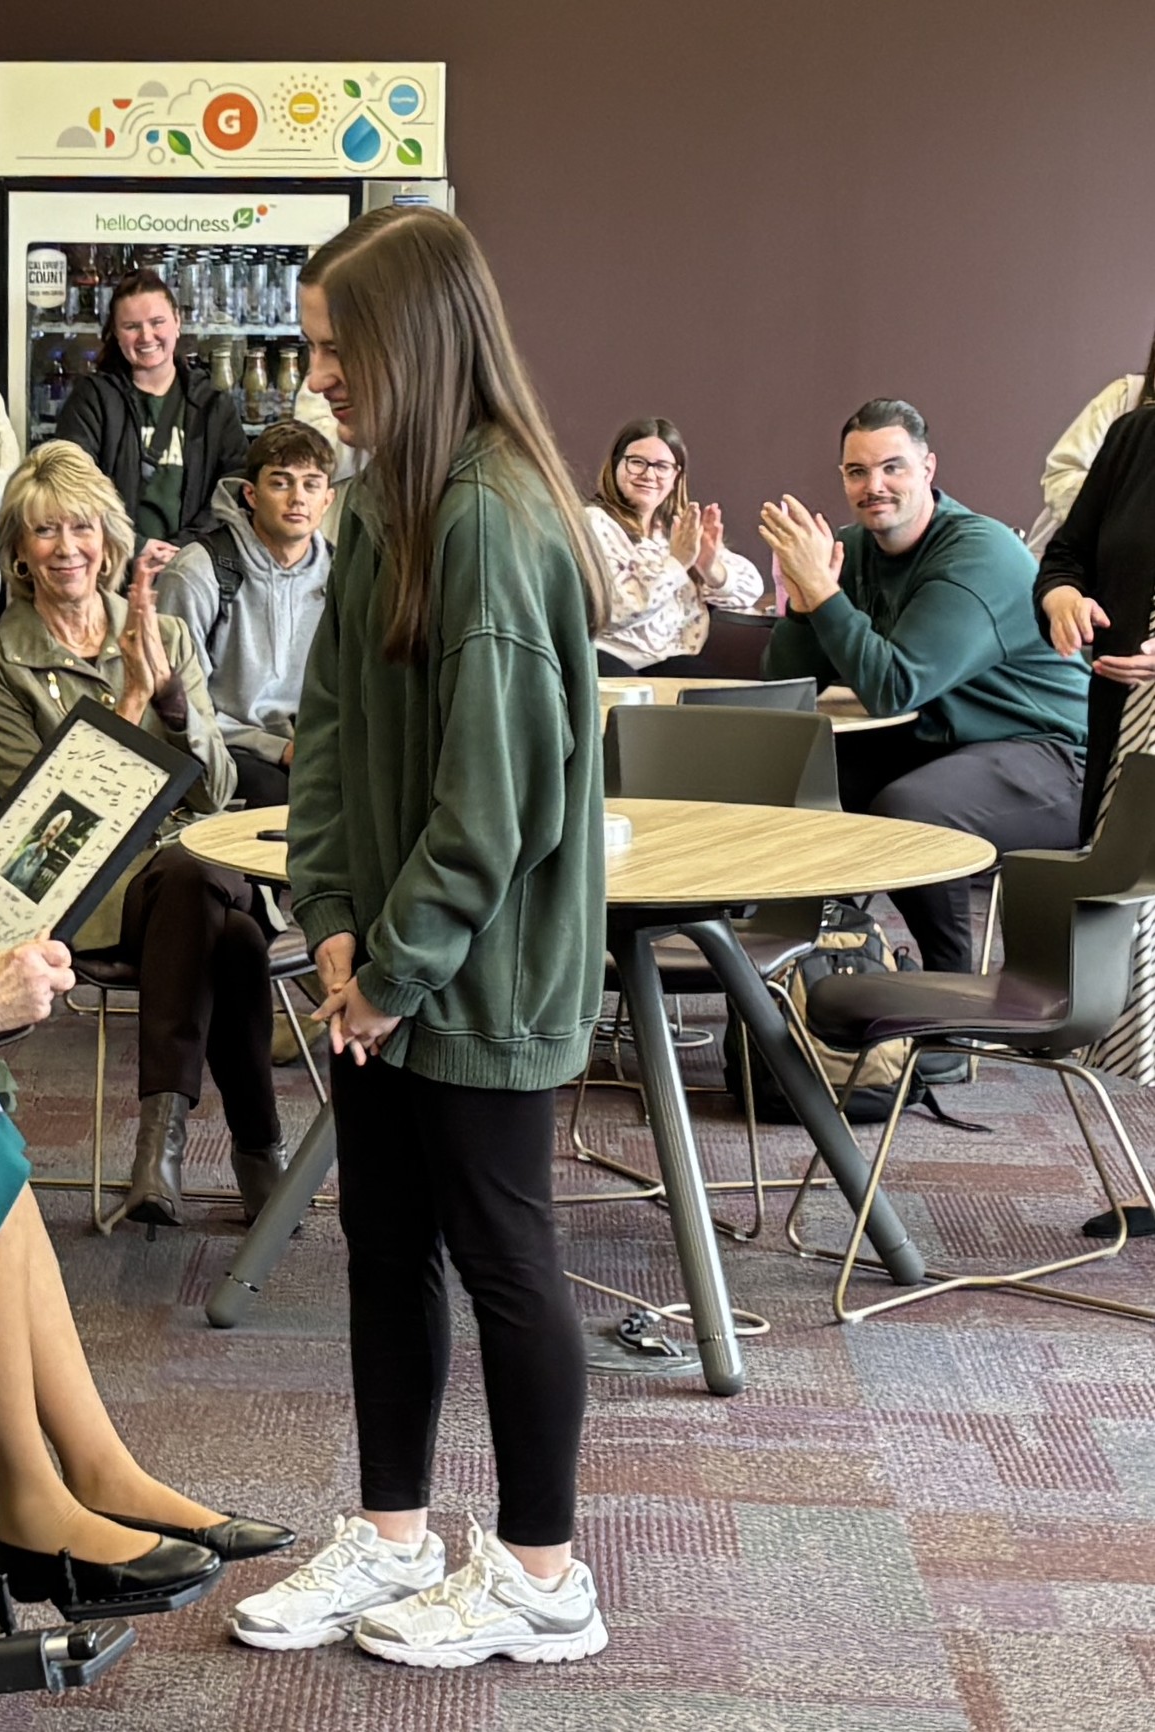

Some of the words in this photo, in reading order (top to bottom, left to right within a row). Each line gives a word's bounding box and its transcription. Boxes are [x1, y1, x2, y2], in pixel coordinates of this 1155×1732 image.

[217, 108, 241, 135] G
[95, 213, 230, 232] helloGoodness
[28, 271, 63, 284] COUNT
